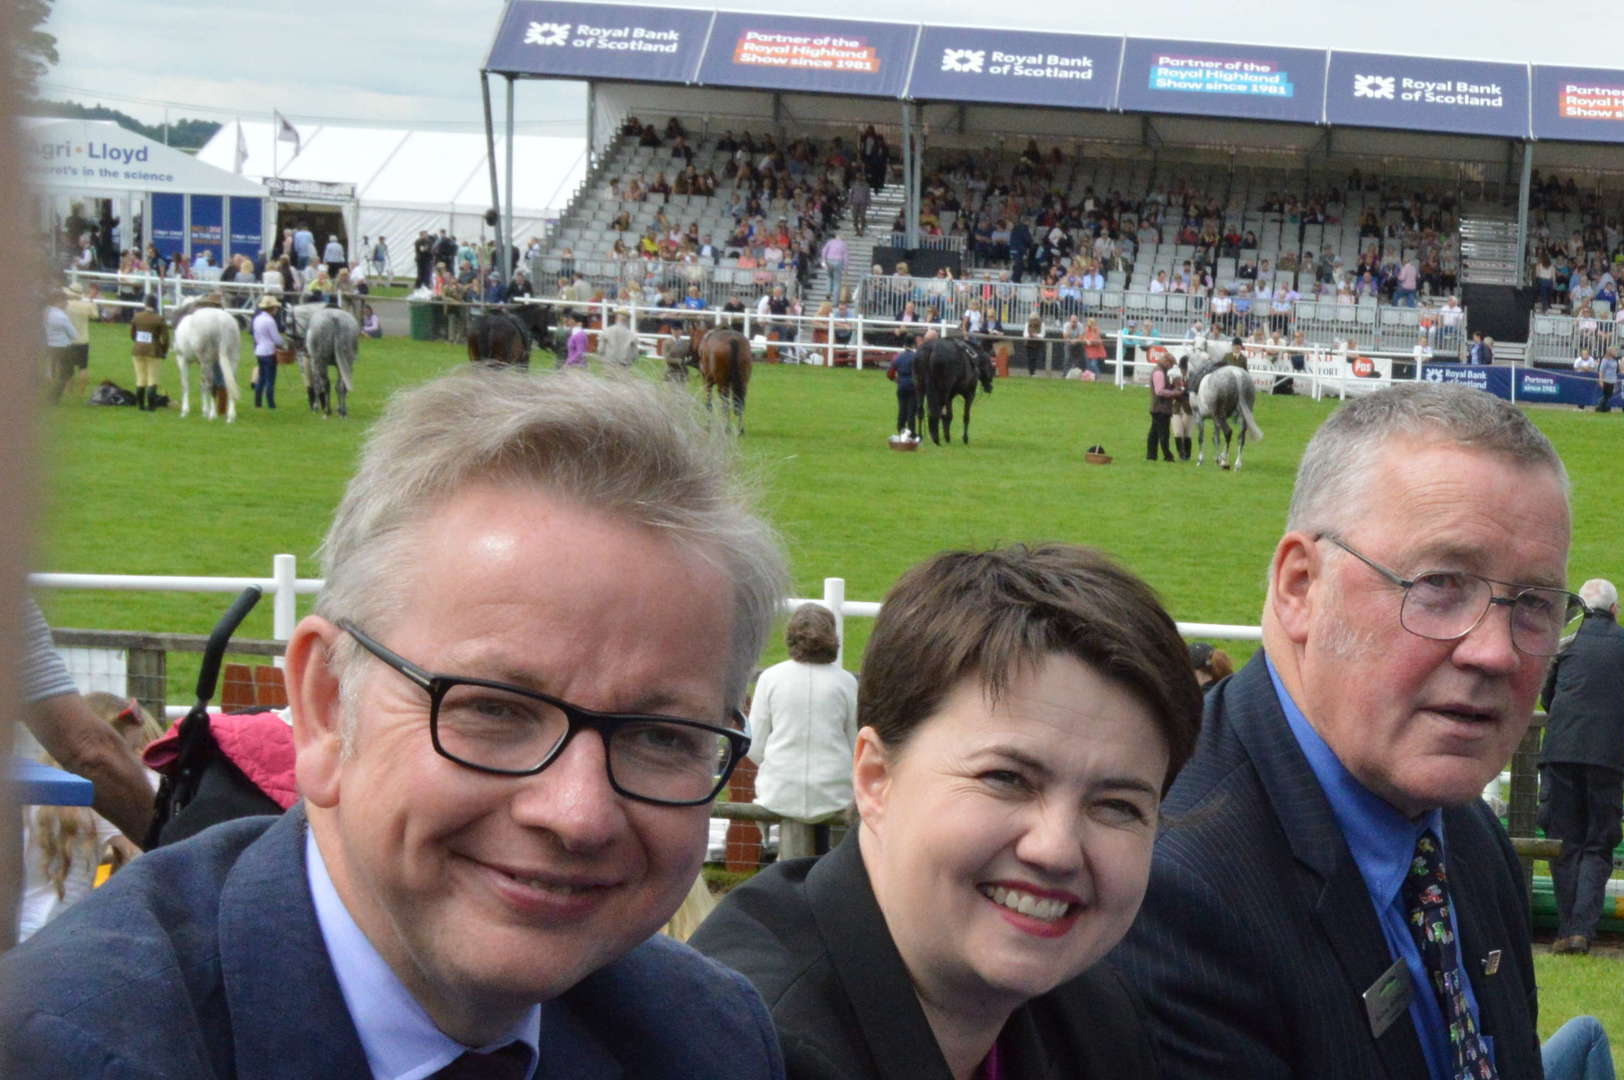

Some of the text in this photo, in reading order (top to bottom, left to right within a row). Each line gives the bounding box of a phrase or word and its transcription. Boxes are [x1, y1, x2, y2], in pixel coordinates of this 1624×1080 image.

[577, 24, 680, 42] Royal Bank
[746, 31, 860, 48] Partner of the
[572, 37, 679, 53] of Scotland
[743, 42, 868, 59] Royal Highland
[740, 53, 872, 71] Show since 1981
[992, 51, 1093, 67] Royal Bank
[1158, 57, 1271, 73] Partner of the
[989, 64, 1093, 80] of Scotland
[1157, 68, 1280, 83] Royal Highland
[1156, 79, 1287, 95] Show since 1981
[1402, 78, 1501, 95] Royal Bank
[1401, 91, 1503, 107] of Scotland
[1566, 96, 1611, 107] Royal
[1566, 107, 1614, 117] Show
[88, 141, 149, 165] Lloyd
[83, 166, 94, 176] in
[100, 167, 120, 178] the
[124, 169, 174, 182] science
[1445, 369, 1487, 379] Royal Bank
